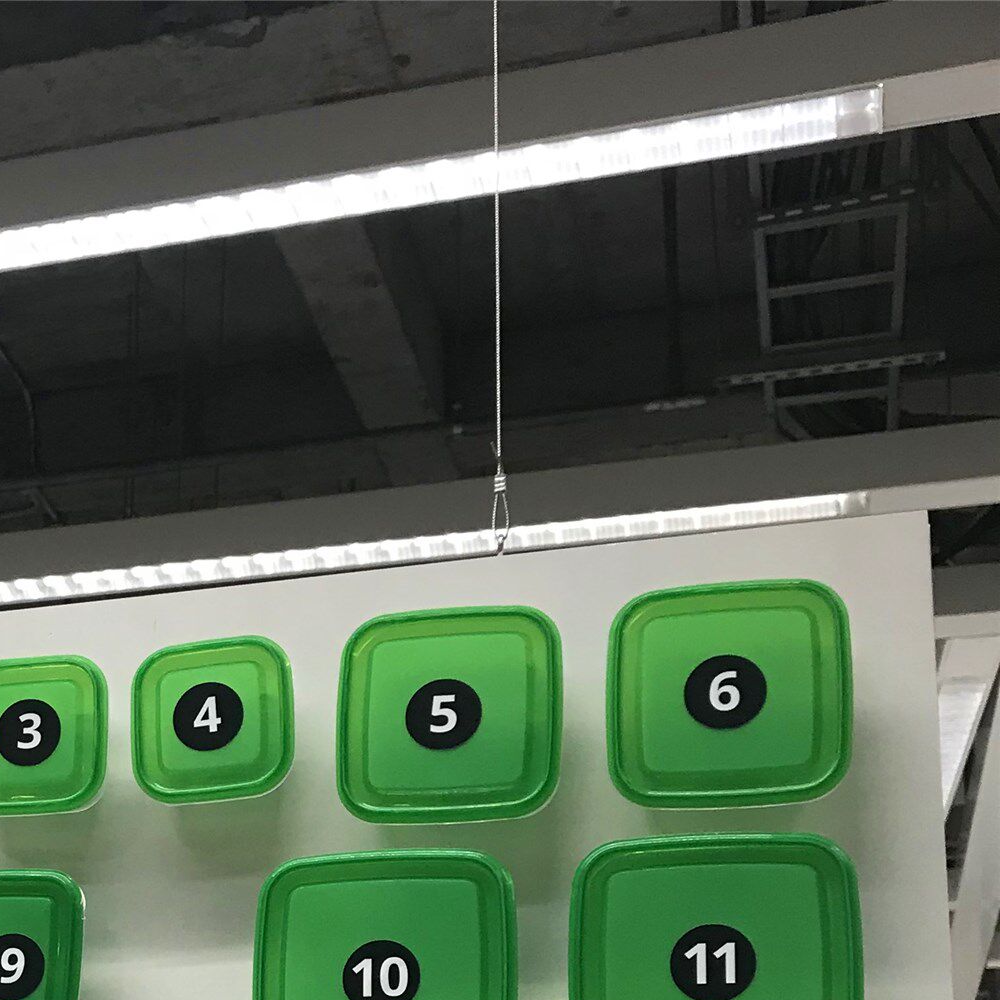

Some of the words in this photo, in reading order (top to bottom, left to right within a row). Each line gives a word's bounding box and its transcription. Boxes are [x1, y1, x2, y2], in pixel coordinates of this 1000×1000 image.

[709, 670, 740, 712] 6
[16, 712, 42, 750] 3
[193, 695, 222, 733] 4
[429, 694, 458, 733] 5
[0, 947, 25, 984] 9
[352, 956, 409, 998] 10
[684, 942, 736, 985] 11
